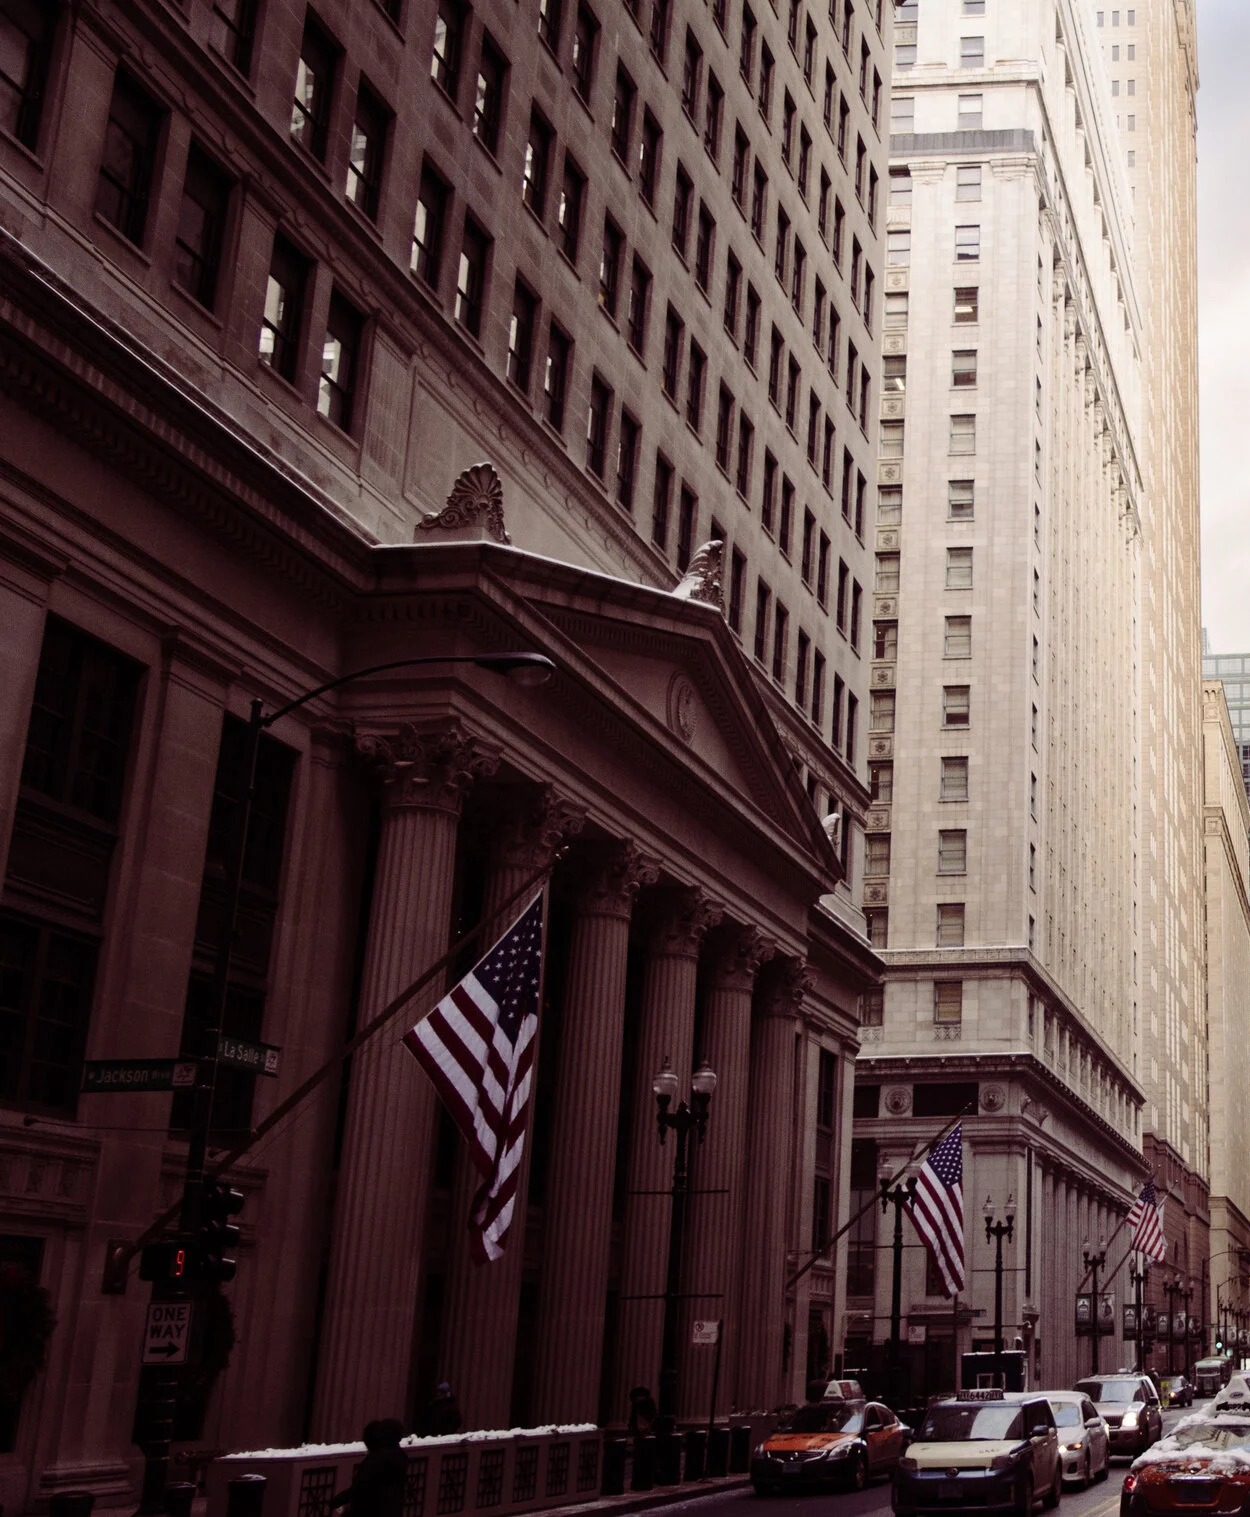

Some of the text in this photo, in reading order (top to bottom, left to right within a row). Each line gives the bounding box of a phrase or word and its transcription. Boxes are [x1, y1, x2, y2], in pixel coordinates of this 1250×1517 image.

[96, 1067, 149, 1084] Jackson
[152, 1307, 186, 1321] ONE
[151, 1324, 185, 1339] WAY
